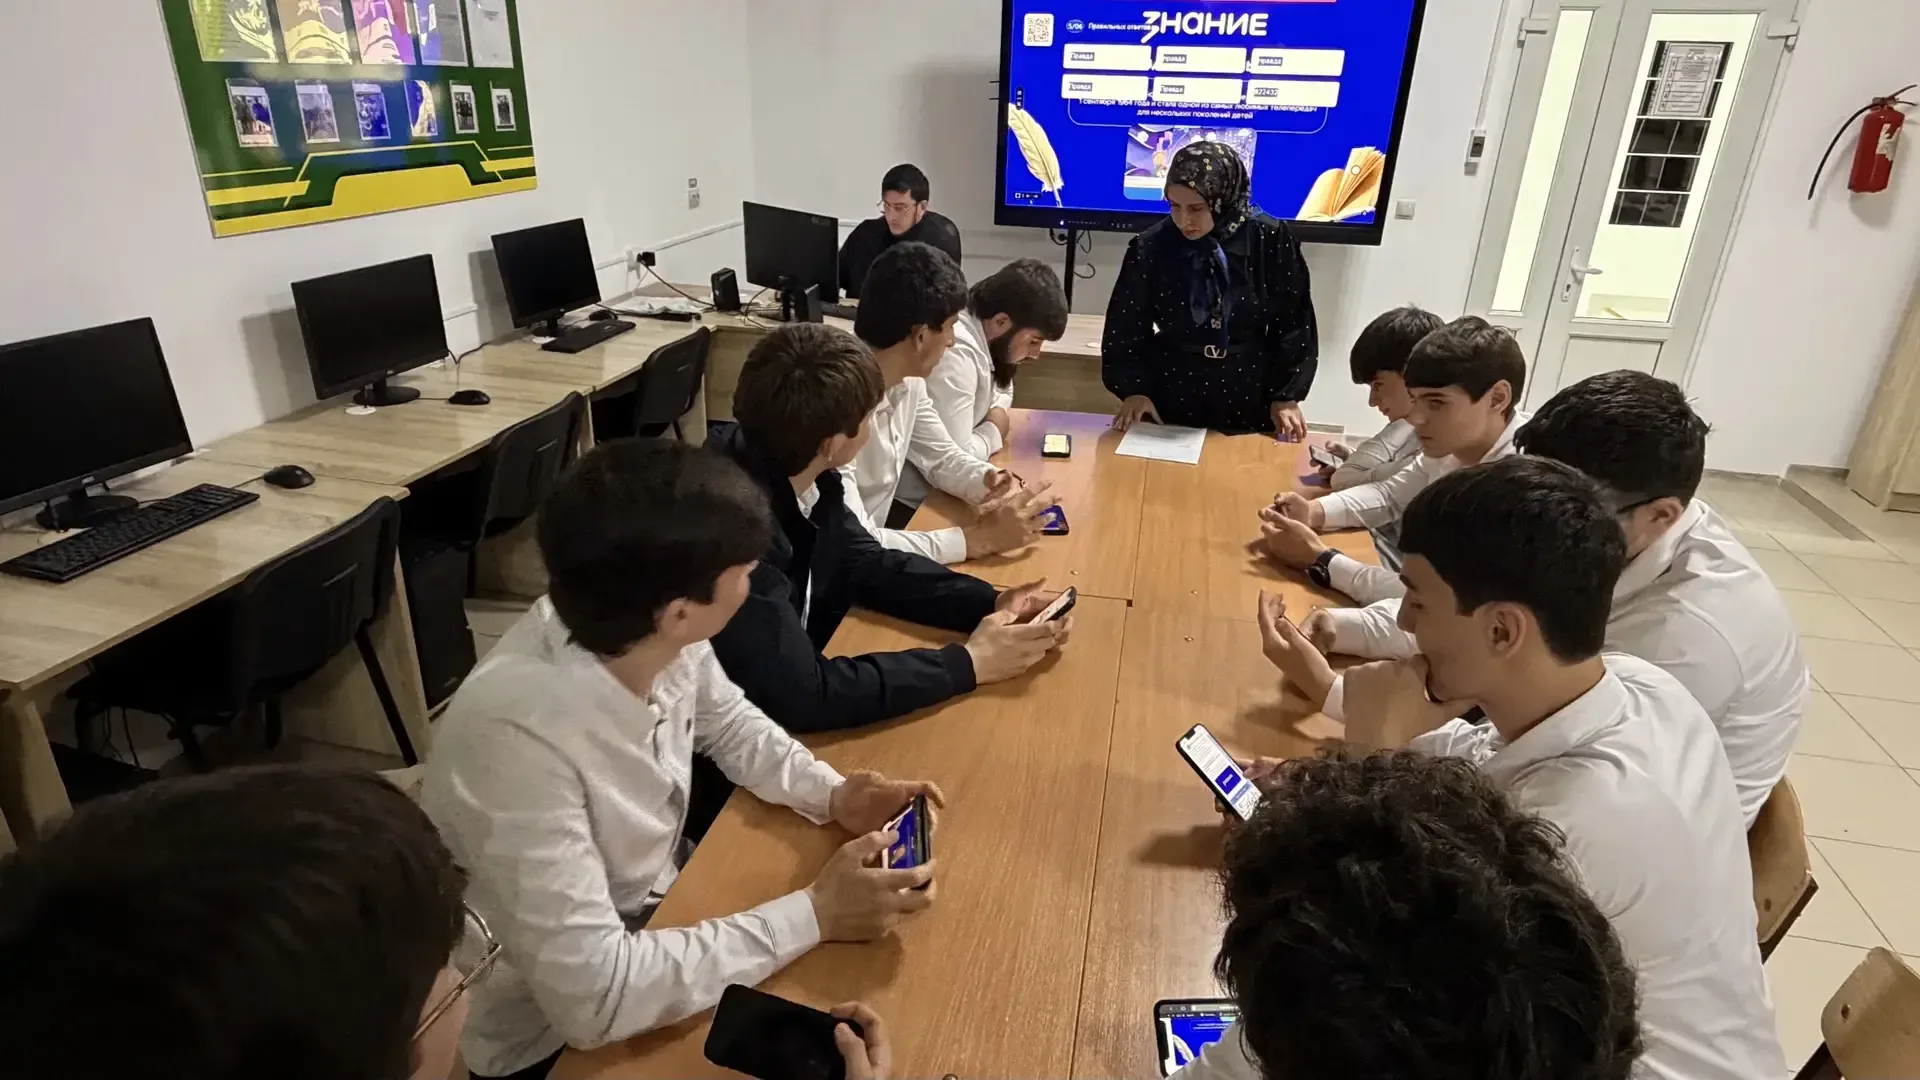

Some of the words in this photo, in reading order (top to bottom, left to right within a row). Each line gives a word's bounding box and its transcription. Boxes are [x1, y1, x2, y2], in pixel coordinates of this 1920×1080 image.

[1088, 22, 1126, 30] Правильных
[1193, 110, 1231, 118] поколений
[1231, 111, 1254, 119] детей
